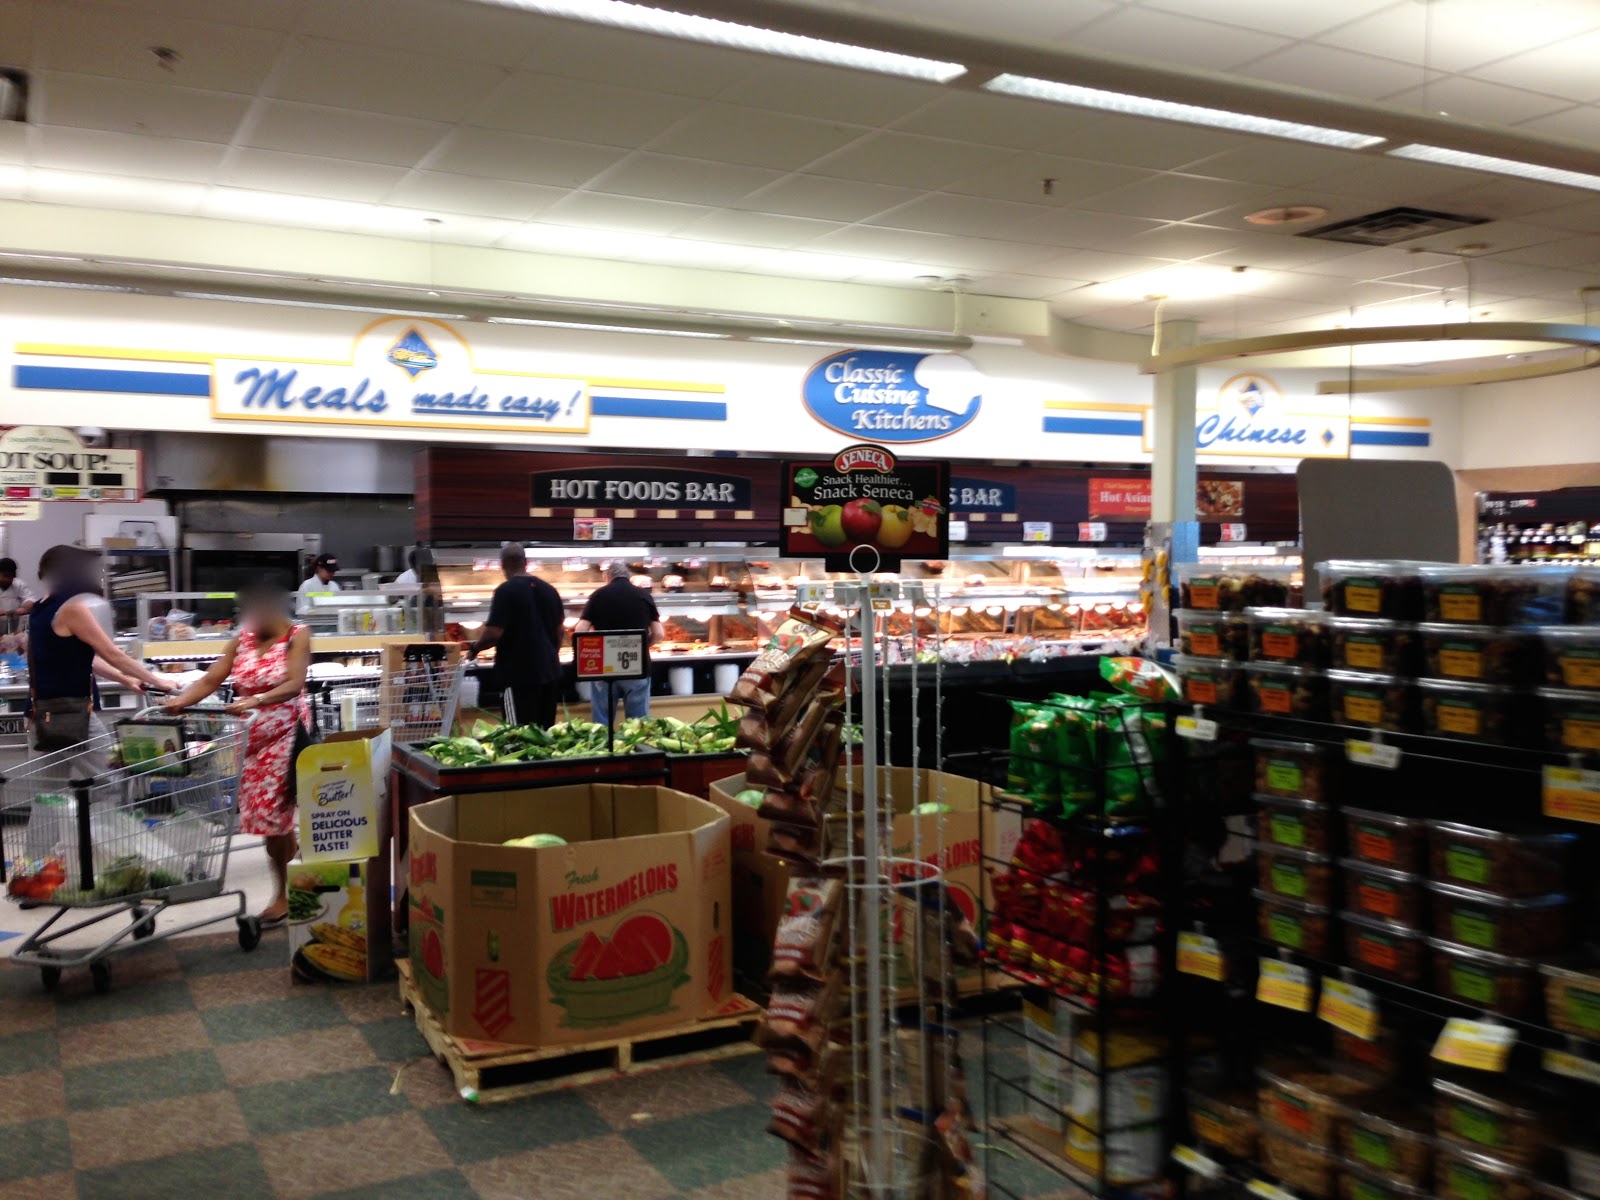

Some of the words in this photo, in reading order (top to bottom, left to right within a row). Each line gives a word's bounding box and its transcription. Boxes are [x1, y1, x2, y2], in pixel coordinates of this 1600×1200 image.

[824, 357, 906, 383] Classic
[234, 367, 389, 413] Meals
[411, 385, 489, 410] made
[834, 382, 920, 405] Cuisine
[851, 404, 952, 430] Kitchens
[1195, 414, 1307, 448] Chinese
[0, 452, 29, 469] OT
[33, 452, 108, 470] SOUP!
[840, 449, 889, 471] SENECA
[822, 474, 851, 485] Snack
[550, 479, 600, 499] HOT
[604, 480, 681, 500] FOODS
[685, 482, 736, 503] BAR
[813, 484, 858, 500] Snack
[862, 485, 914, 500] Seneca
[961, 487, 1003, 506] BAR
[1100, 491, 1121, 502] Hot
[316, 784, 355, 807] Butter!
[311, 810, 336, 819] SPRAY
[312, 816, 368, 830] DELICIOUS
[312, 829, 353, 842] BUTTER
[313, 841, 349, 853] TASTE!
[565, 867, 599, 889] Fresh
[551, 863, 679, 931] WATERMELONS
